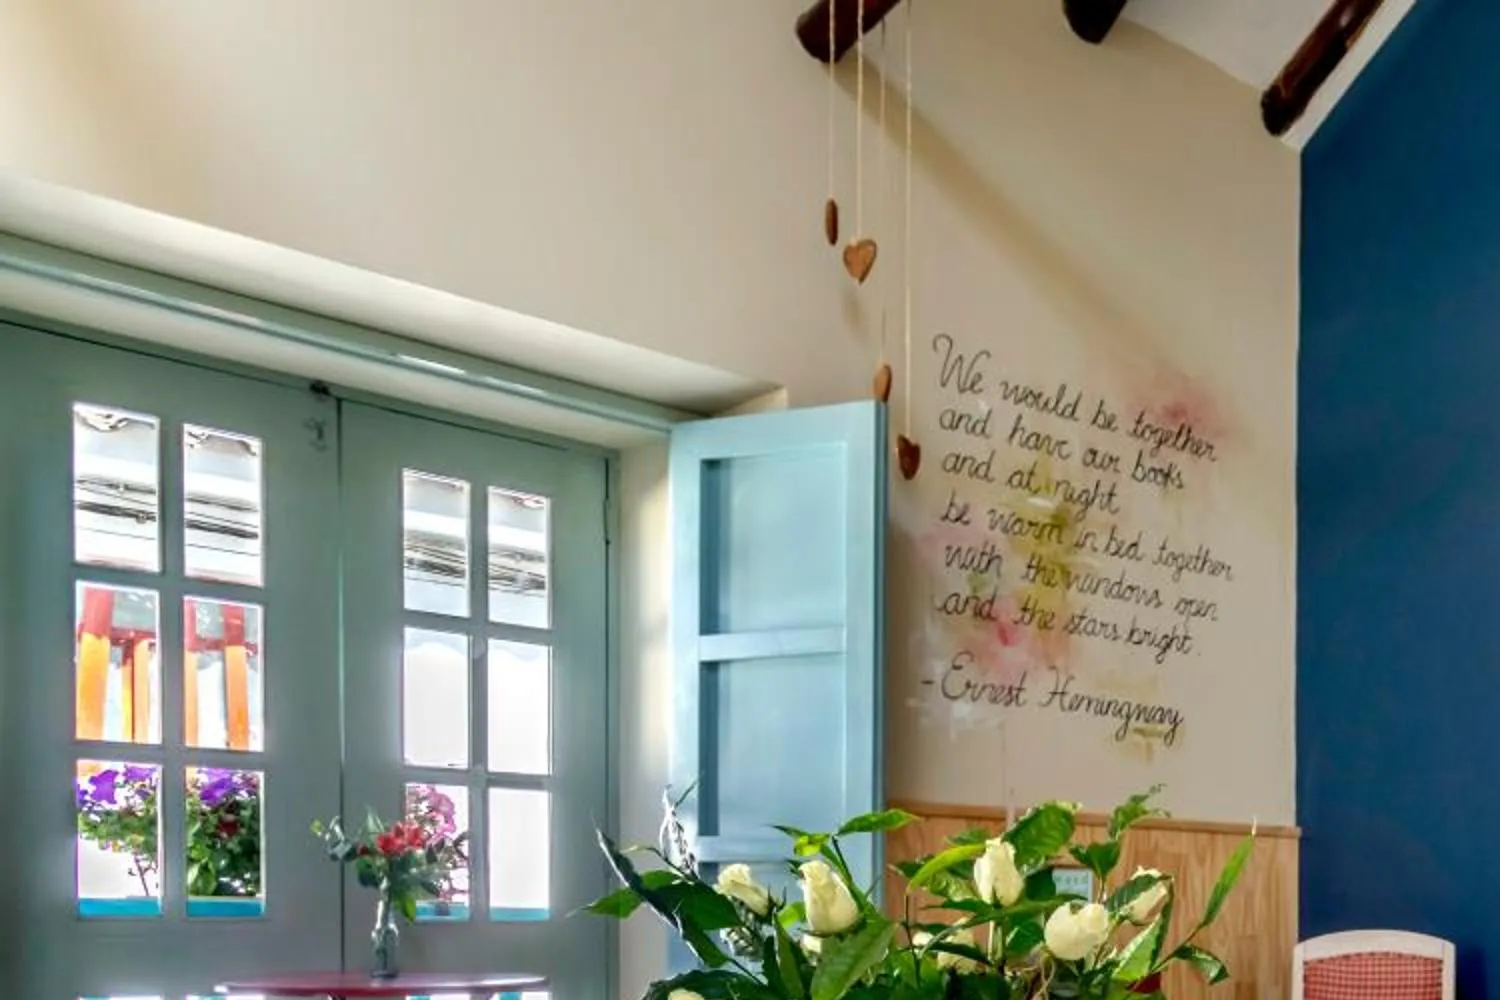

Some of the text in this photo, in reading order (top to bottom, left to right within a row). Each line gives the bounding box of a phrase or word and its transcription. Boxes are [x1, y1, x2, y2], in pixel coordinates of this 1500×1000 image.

[933, 334, 1218, 462] We would be together
[939, 408, 1184, 490] and have our books
[942, 450, 1120, 522] and at night
[940, 489, 1234, 582] be warm in bed together
[945, 541, 1003, 580] with
[1020, 552, 1057, 590] the
[936, 586, 999, 623] and
[1013, 598, 1056, 632] the
[1064, 608, 1121, 640] stars
[1039, 665, 1185, 746] Hemingway
